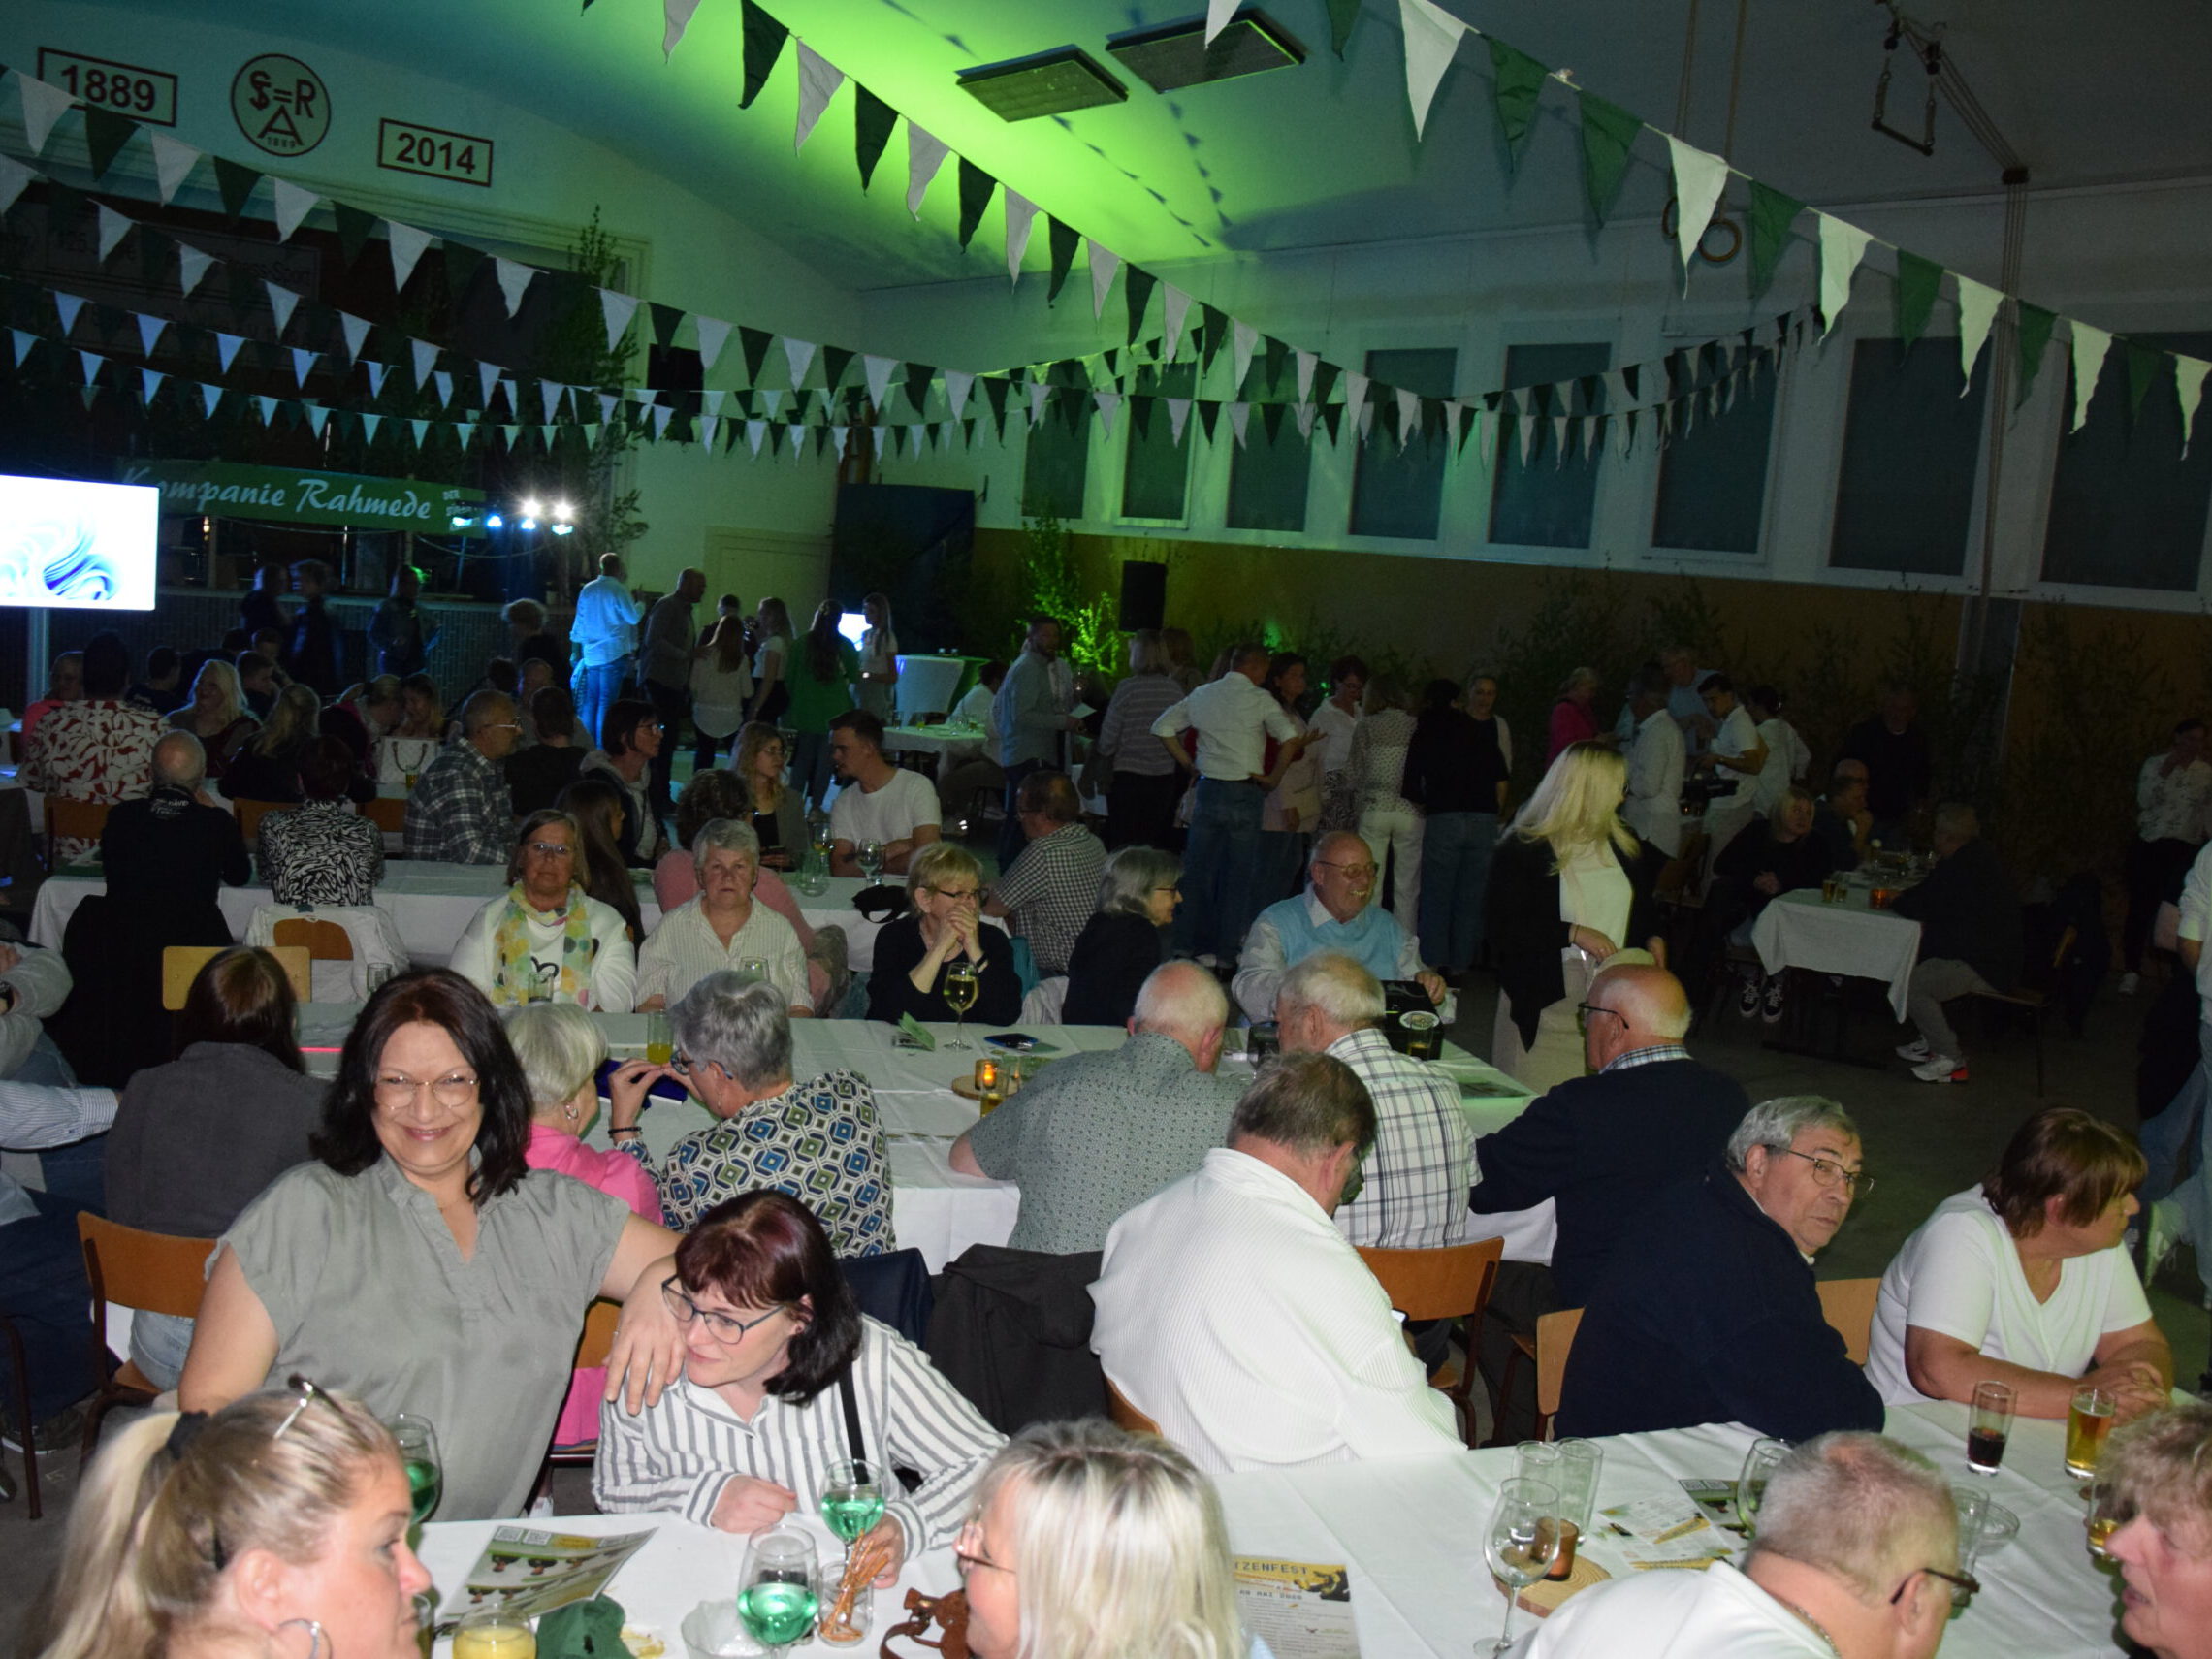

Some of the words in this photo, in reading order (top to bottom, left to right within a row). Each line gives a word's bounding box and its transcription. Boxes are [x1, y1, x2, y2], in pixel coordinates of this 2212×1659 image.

[60, 63, 156, 112] 1889
[395, 133, 476, 175] 2014
[294, 478, 431, 520] Rahmede
